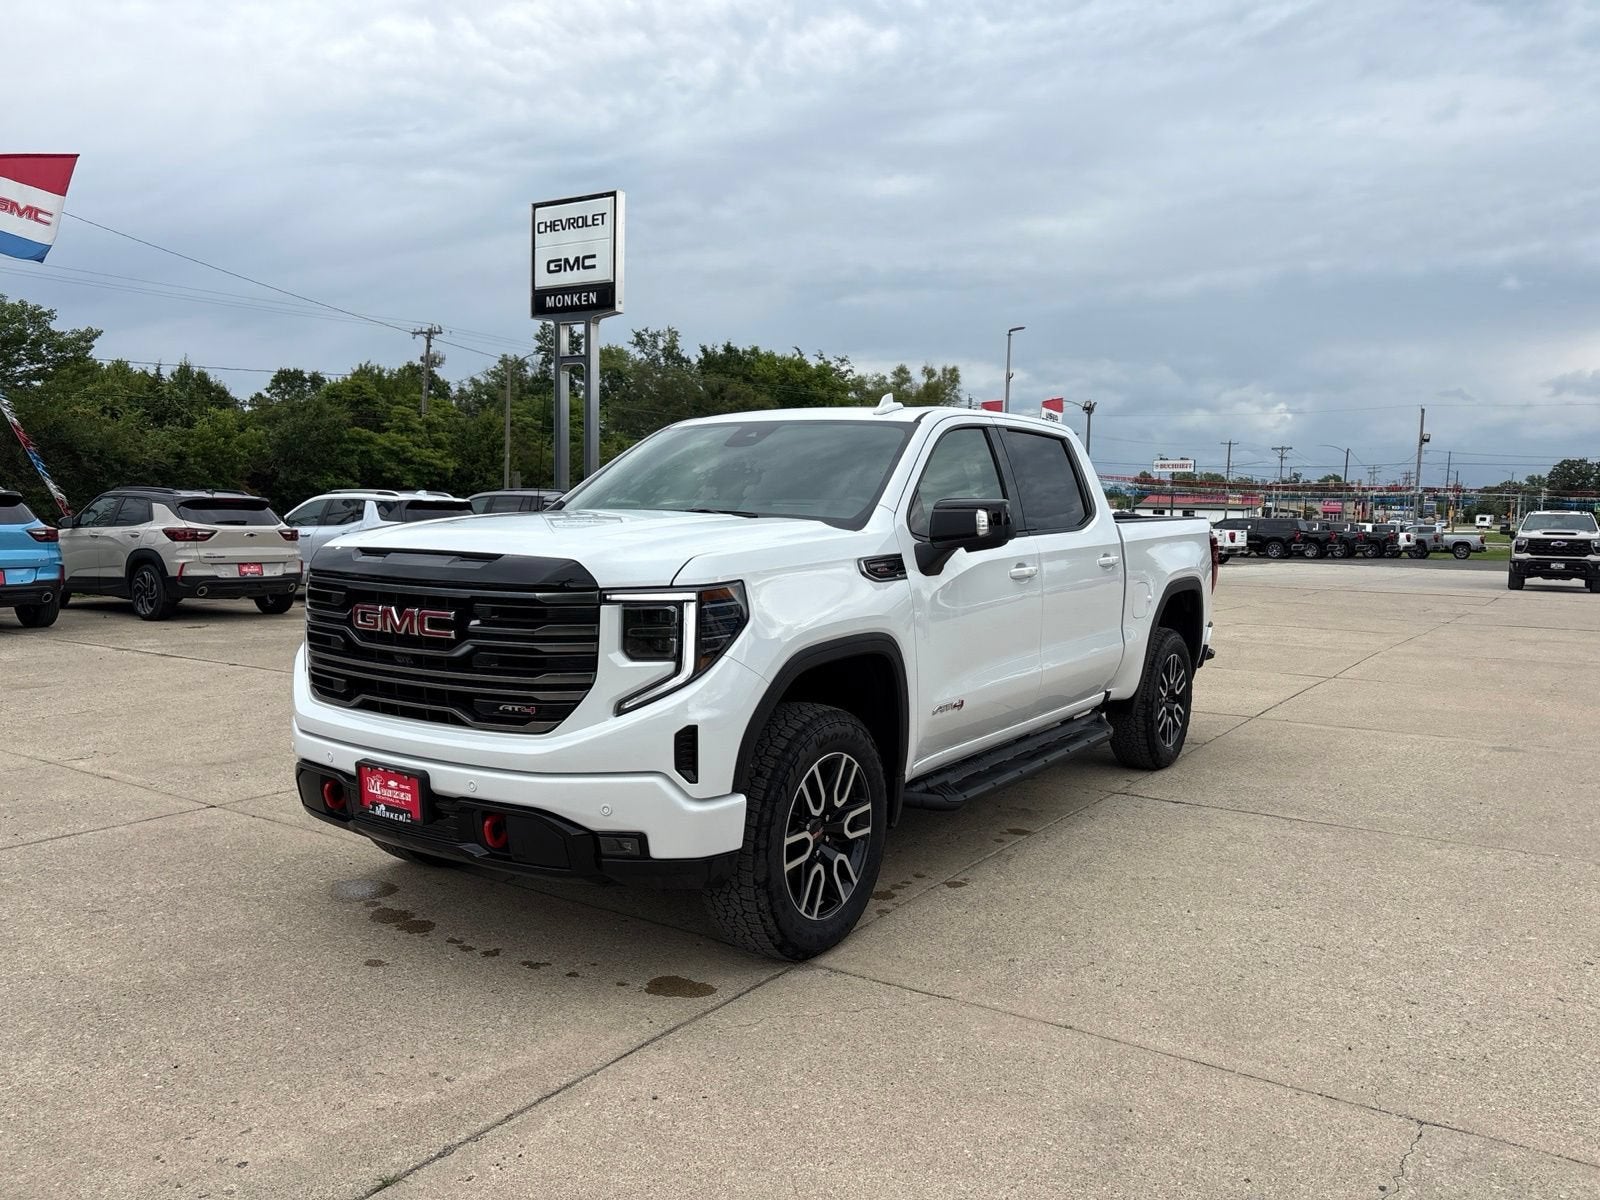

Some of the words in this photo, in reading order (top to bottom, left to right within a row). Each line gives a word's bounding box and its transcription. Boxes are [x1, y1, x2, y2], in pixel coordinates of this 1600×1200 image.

[537, 212, 607, 235] CHEVROLET
[546, 253, 597, 274] GMC
[545, 291, 597, 308] MONKEN
[352, 603, 456, 640] GMC
[498, 704, 536, 715] AT4
